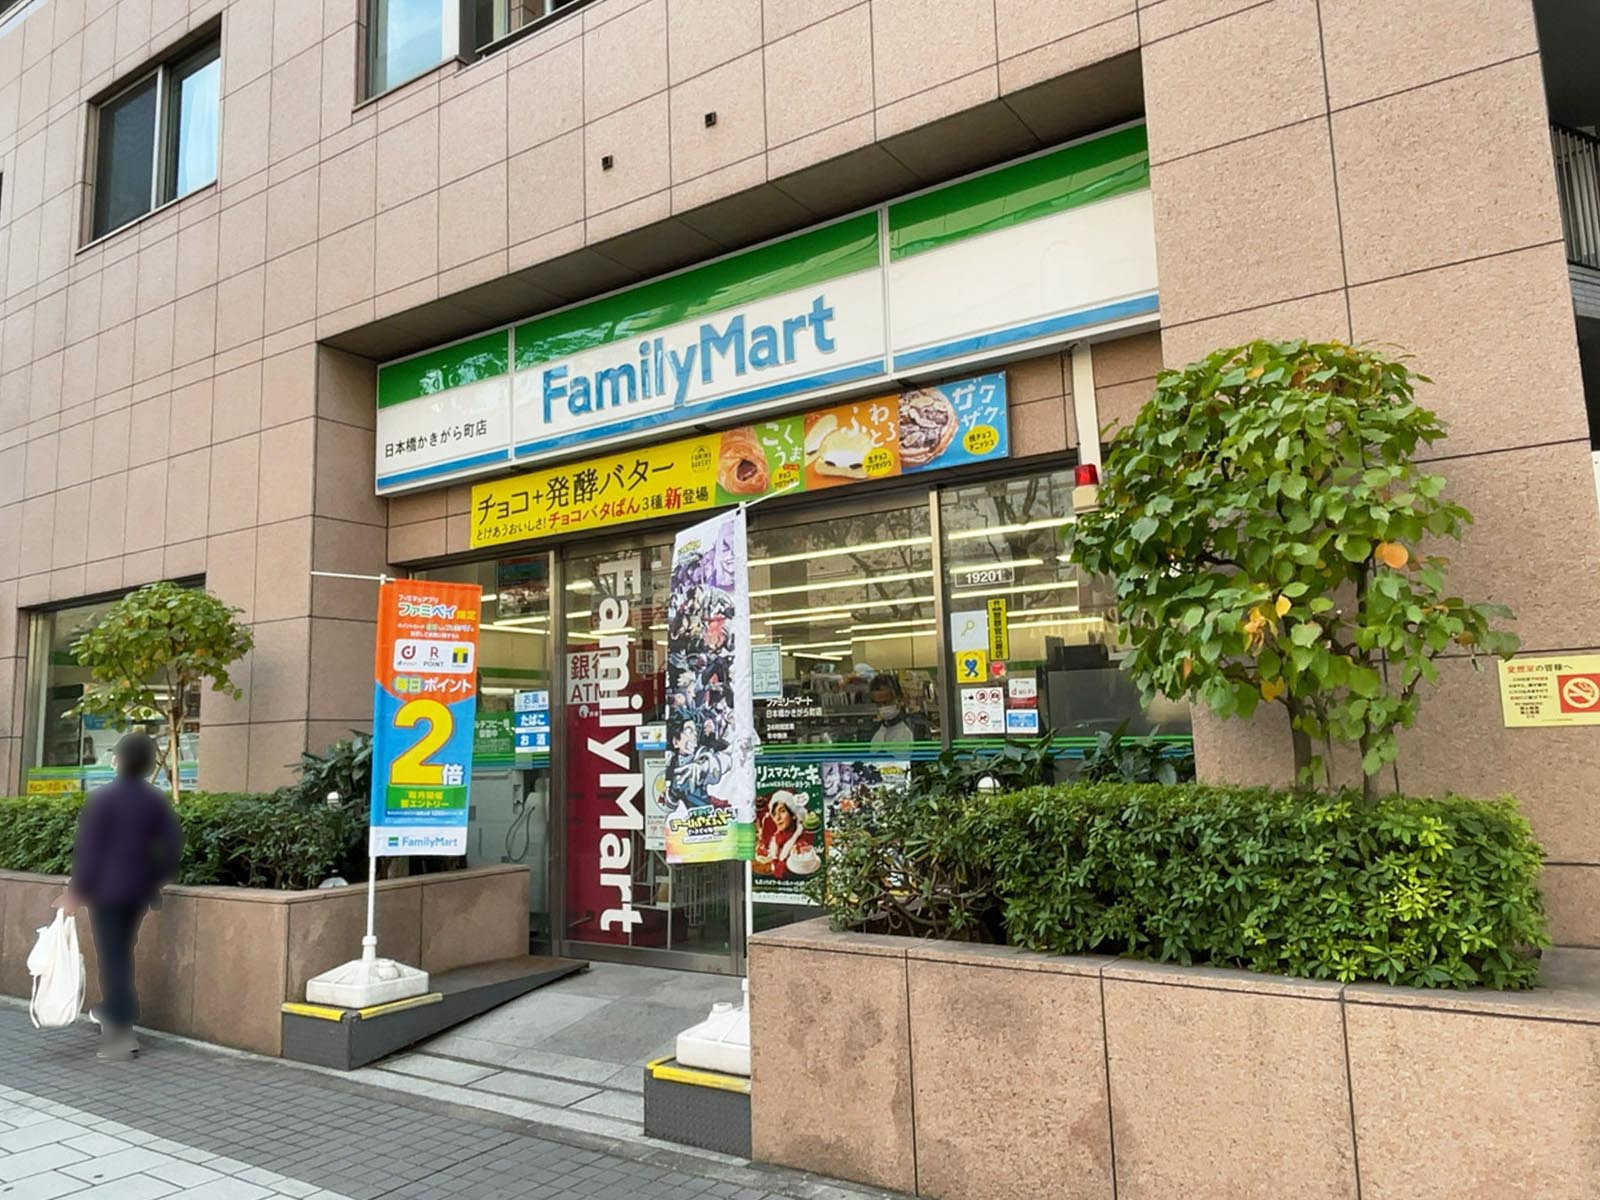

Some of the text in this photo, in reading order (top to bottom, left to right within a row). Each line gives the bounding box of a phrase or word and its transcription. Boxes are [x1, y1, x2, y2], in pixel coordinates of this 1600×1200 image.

[542, 295, 836, 425] FamilyMart
[840, 402, 889, 439] ふわ
[384, 419, 488, 459] 日本橋かきがら町店
[762, 420, 793, 447] こく
[871, 420, 897, 447] とろ
[775, 445, 803, 467] うま
[477, 458, 674, 526] チョコ+発酵バター
[965, 570, 1002, 584] 19201
[398, 602, 457, 620] ファミペイ
[430, 646, 439, 658] R
[766, 696, 814, 708] ファミリーマート
[520, 713, 546, 727] たばこ
[587, 556, 643, 934] FamilyMart
[401, 836, 458, 849] FamilyMart
